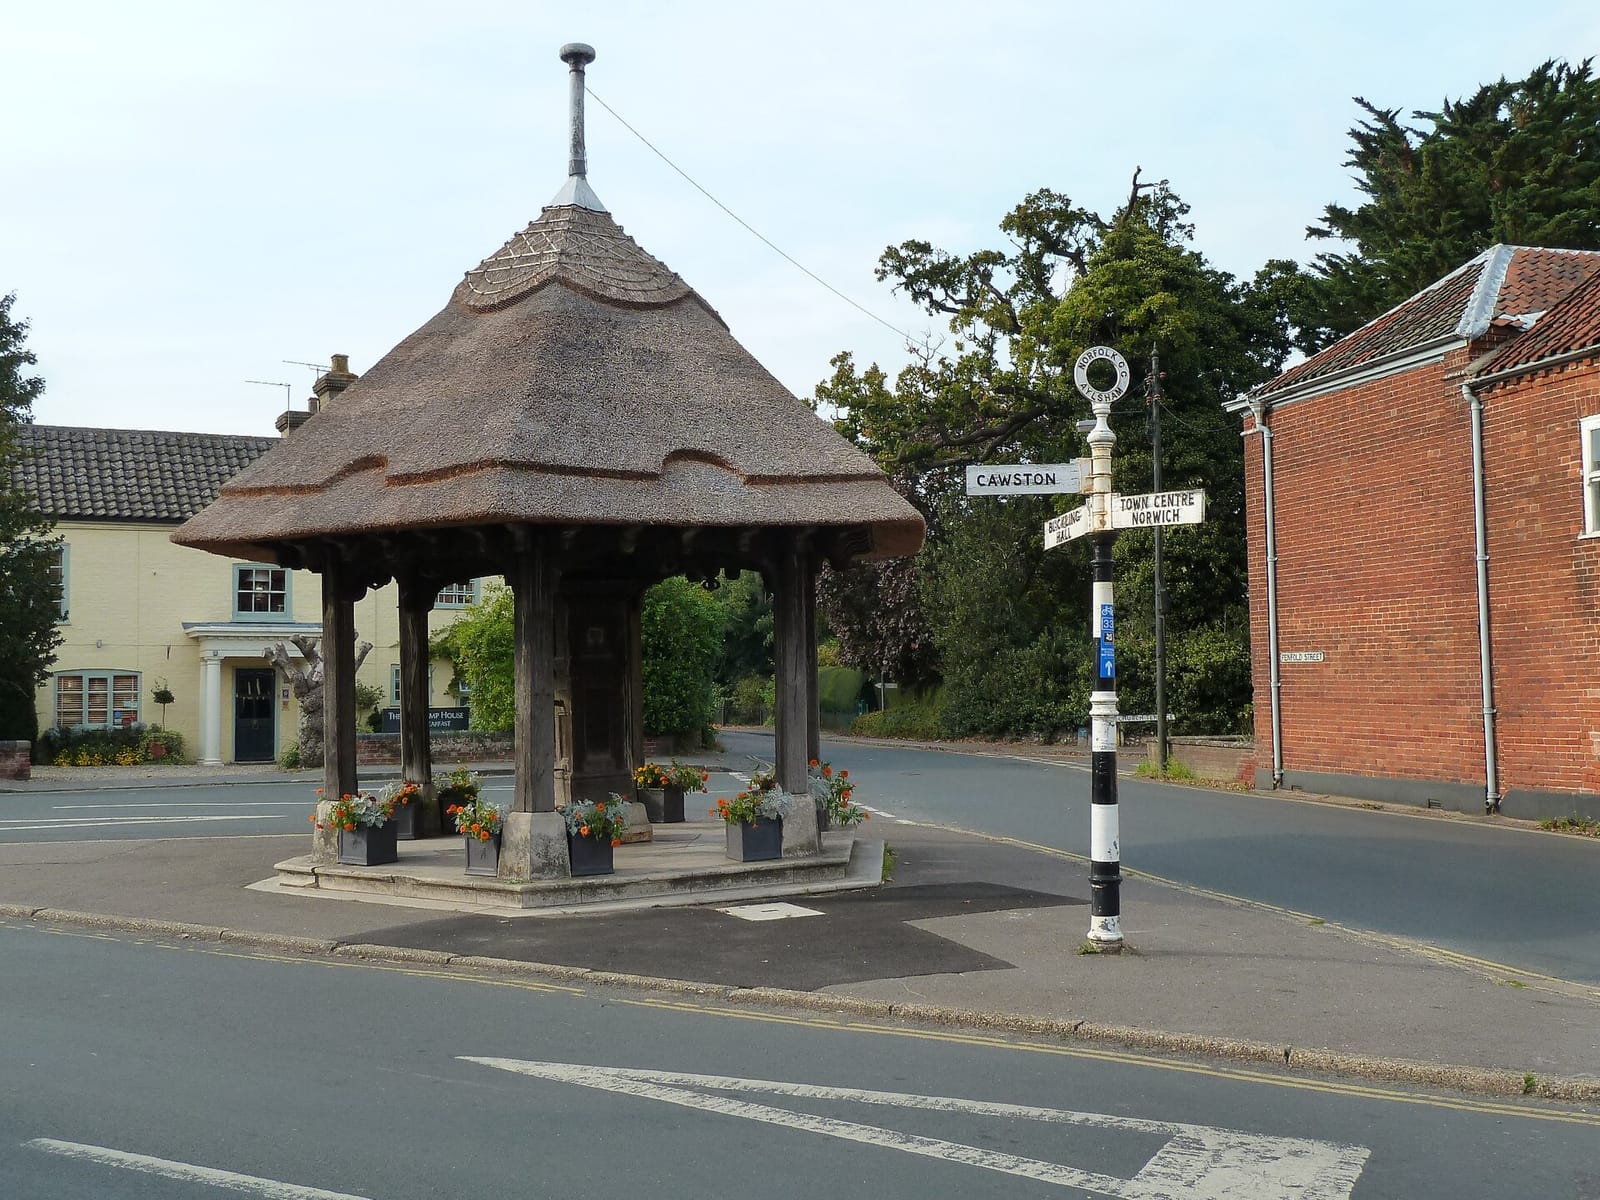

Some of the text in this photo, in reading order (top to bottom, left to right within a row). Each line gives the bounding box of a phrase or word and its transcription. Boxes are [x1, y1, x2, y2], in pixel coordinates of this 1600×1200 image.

[1078, 348, 1118, 370] NORFOLK
[1080, 383, 1124, 402] AYLSHAM
[976, 472, 1056, 487] CAWSTON
[1120, 492, 1195, 511] TOWN CENTRE
[1131, 509, 1180, 525] NORWICH
[1056, 527, 1072, 543] HALL
[1304, 653, 1322, 661] STREET
